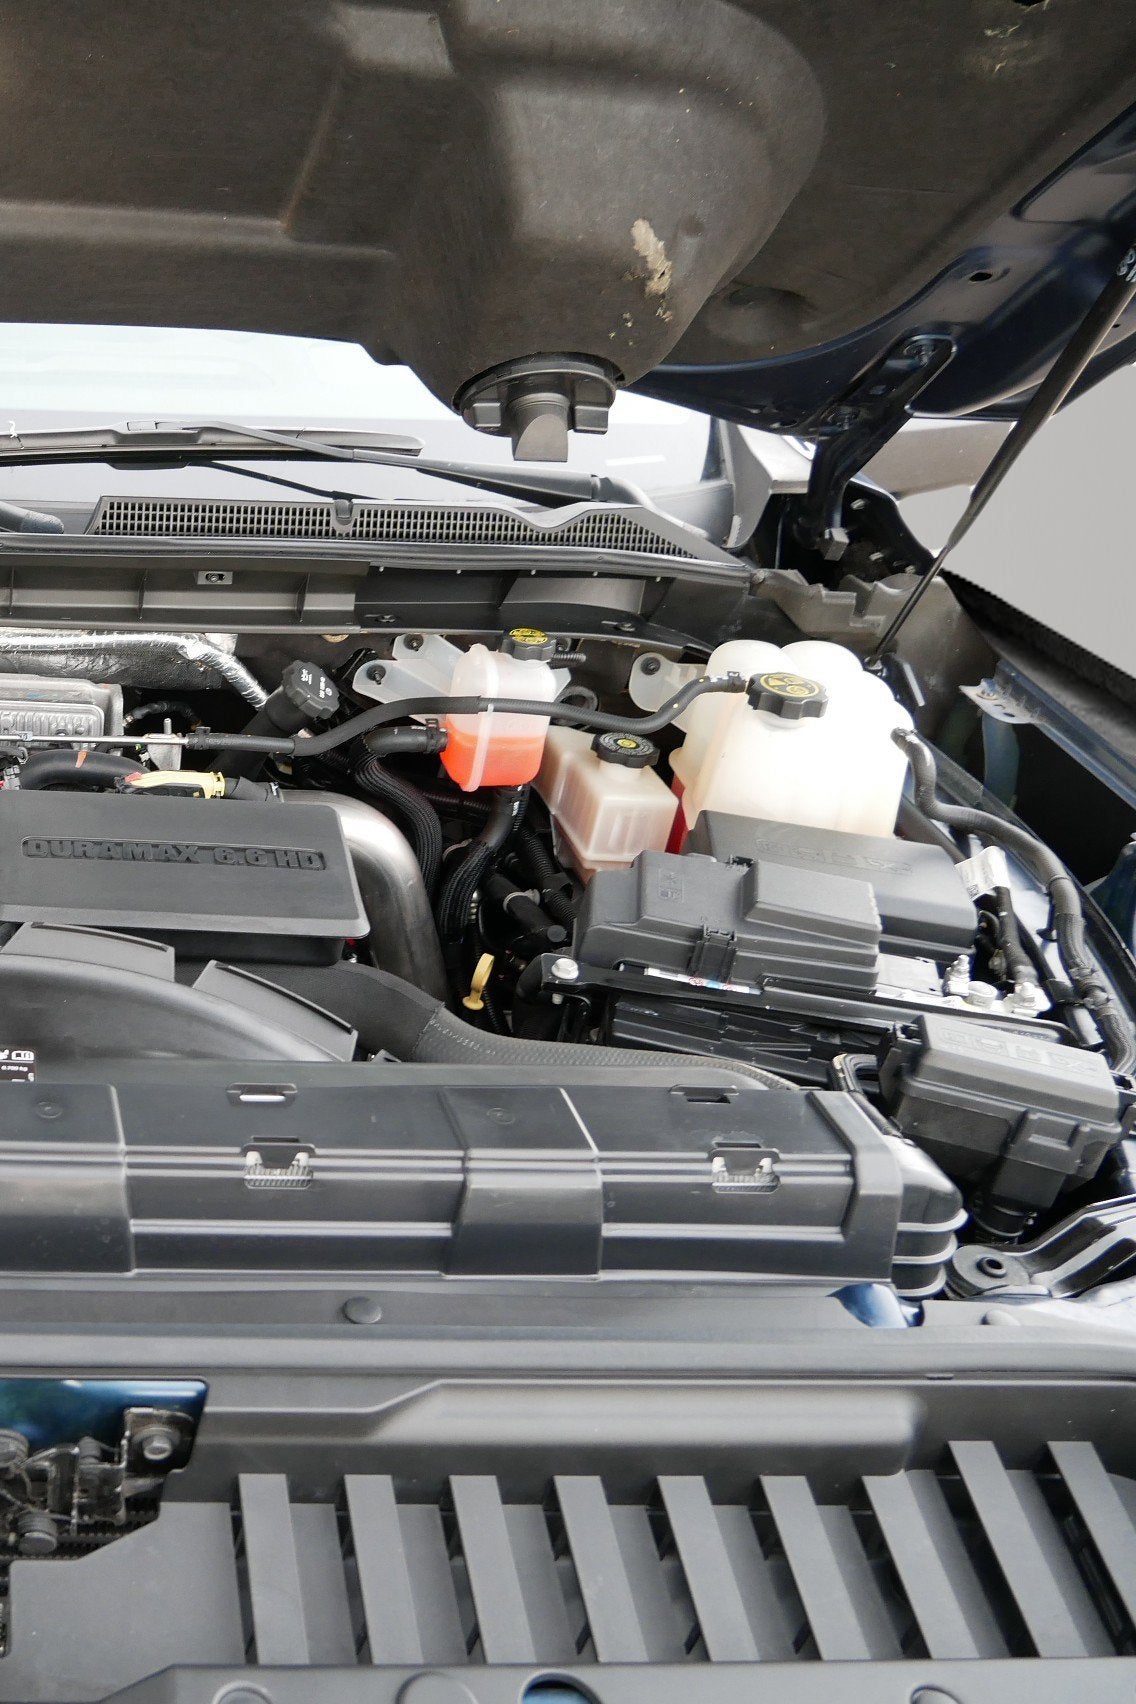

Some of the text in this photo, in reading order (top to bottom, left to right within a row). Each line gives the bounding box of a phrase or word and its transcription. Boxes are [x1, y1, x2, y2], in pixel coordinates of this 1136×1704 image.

[26, 839, 324, 870] DURAMAX 6.6 HD
